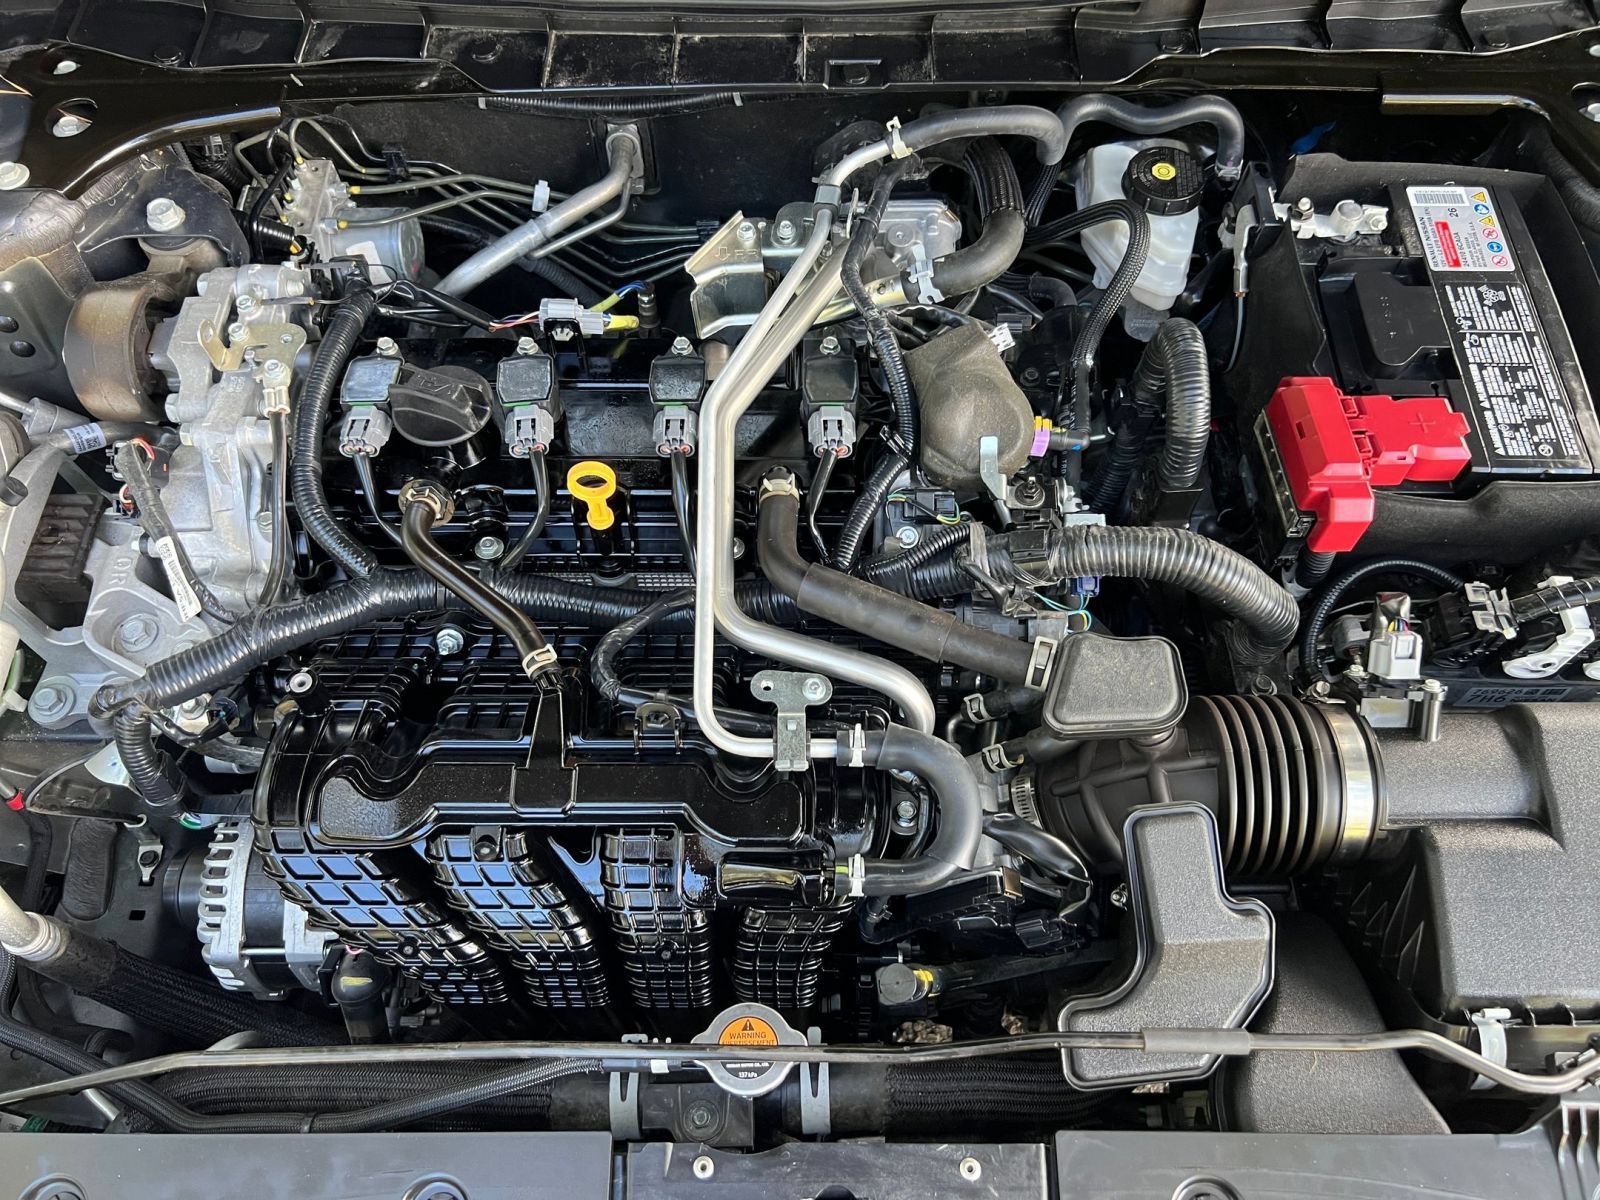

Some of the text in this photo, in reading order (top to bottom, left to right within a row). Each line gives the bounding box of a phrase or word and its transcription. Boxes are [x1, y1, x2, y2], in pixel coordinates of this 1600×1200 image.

[1446, 207, 1459, 217] 26
[1417, 216, 1440, 267] RENAULT NISSAN
